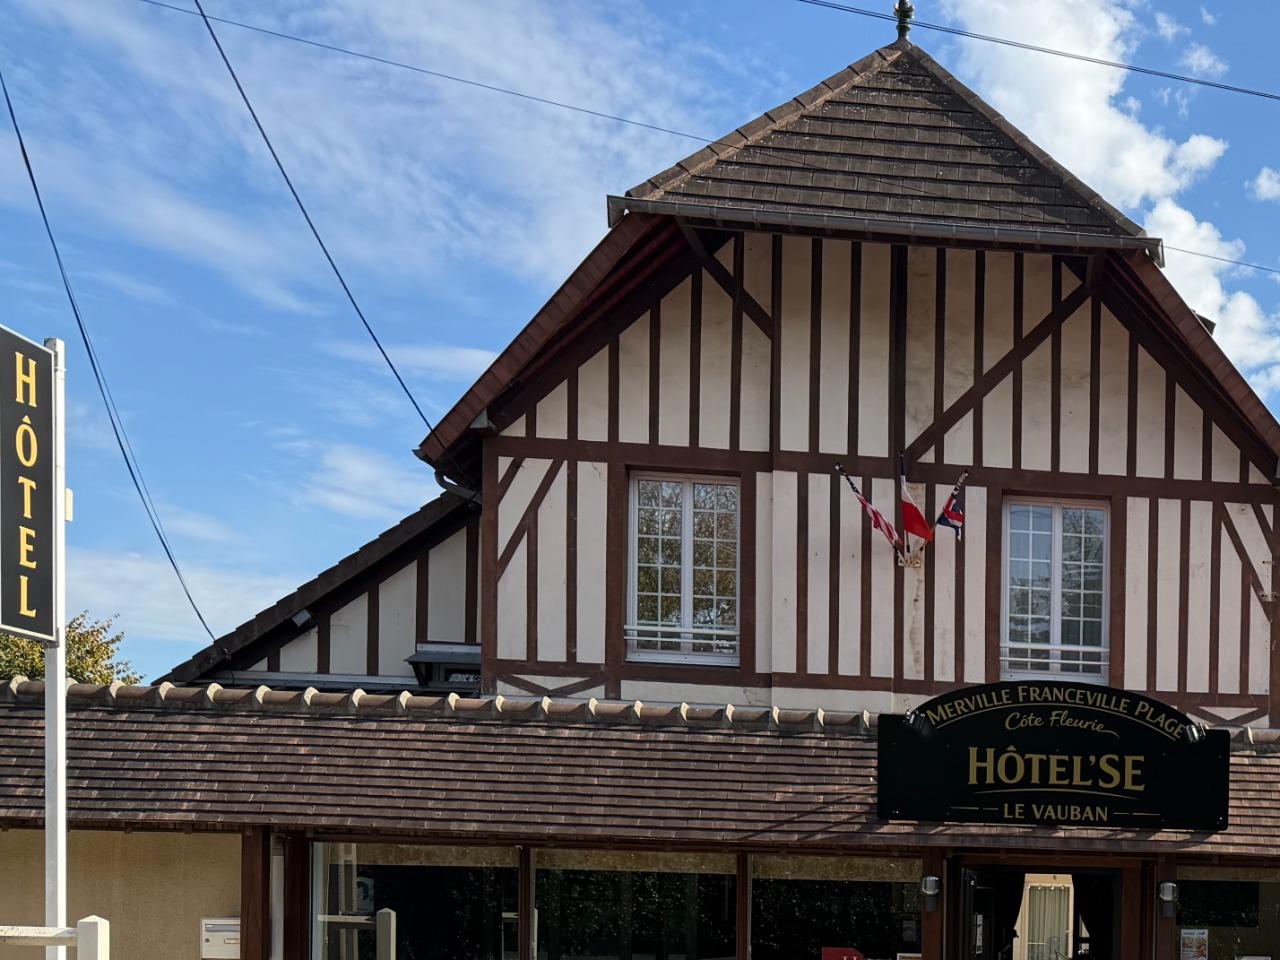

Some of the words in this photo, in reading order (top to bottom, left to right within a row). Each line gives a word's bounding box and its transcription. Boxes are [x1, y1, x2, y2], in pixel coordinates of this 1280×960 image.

[15, 351, 37, 617] HÔTEL
[926, 689, 1012, 727] MERVILLE
[1017, 685, 1128, 713] FRANCEVILLE
[1134, 702, 1185, 739] PLAGE
[1005, 711, 1044, 730] Côte
[1049, 710, 1115, 735] Fleurie
[967, 745, 1145, 791] HÔTEL'SE
[1003, 804, 1025, 819] LE
[1032, 804, 1108, 822] VAUBAN
